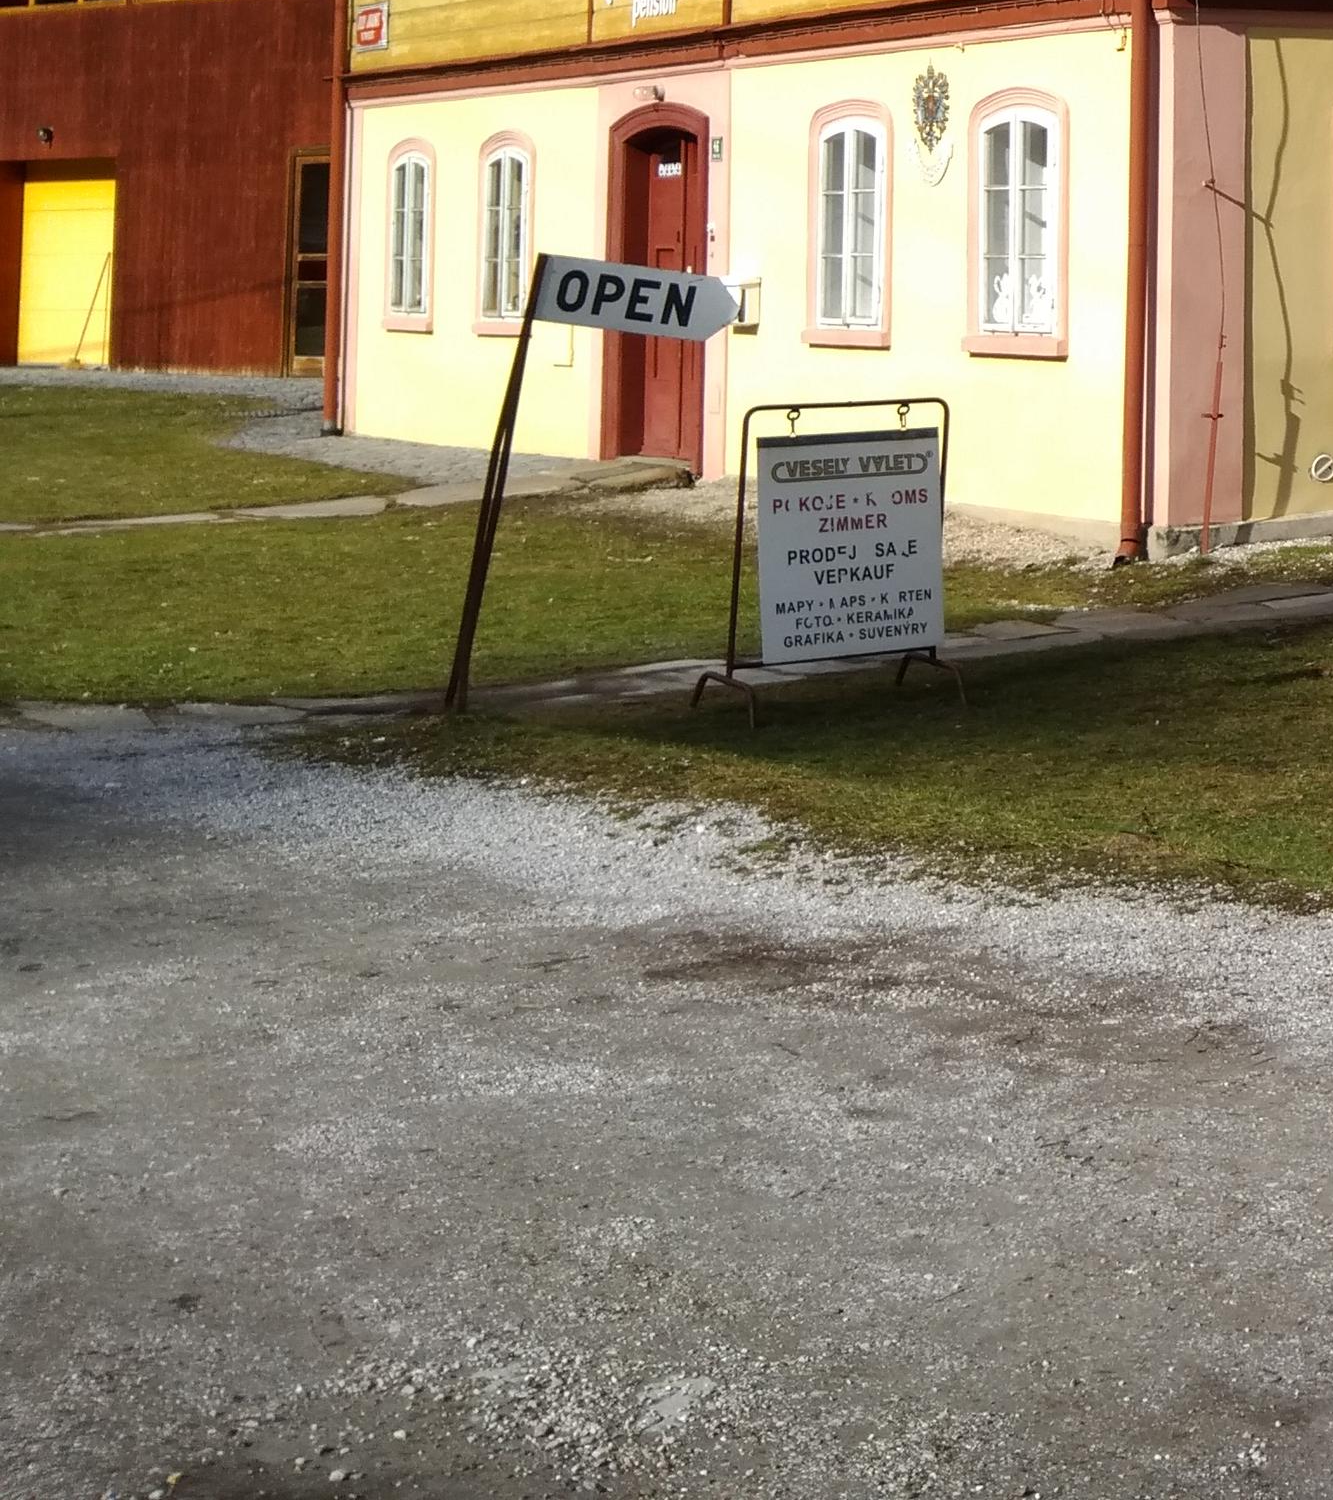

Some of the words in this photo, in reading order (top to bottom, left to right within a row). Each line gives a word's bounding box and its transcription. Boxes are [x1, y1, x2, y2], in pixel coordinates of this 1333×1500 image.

[556, 269, 697, 327] OPEN
[818, 513, 888, 533] ZIMMER
[775, 599, 814, 615] MAPY
[880, 588, 932, 605] KRTEN
[847, 606, 914, 625] KERAMIKA
[783, 630, 845, 648] GRAFIKA
[859, 621, 928, 641] SUVENÝRY
